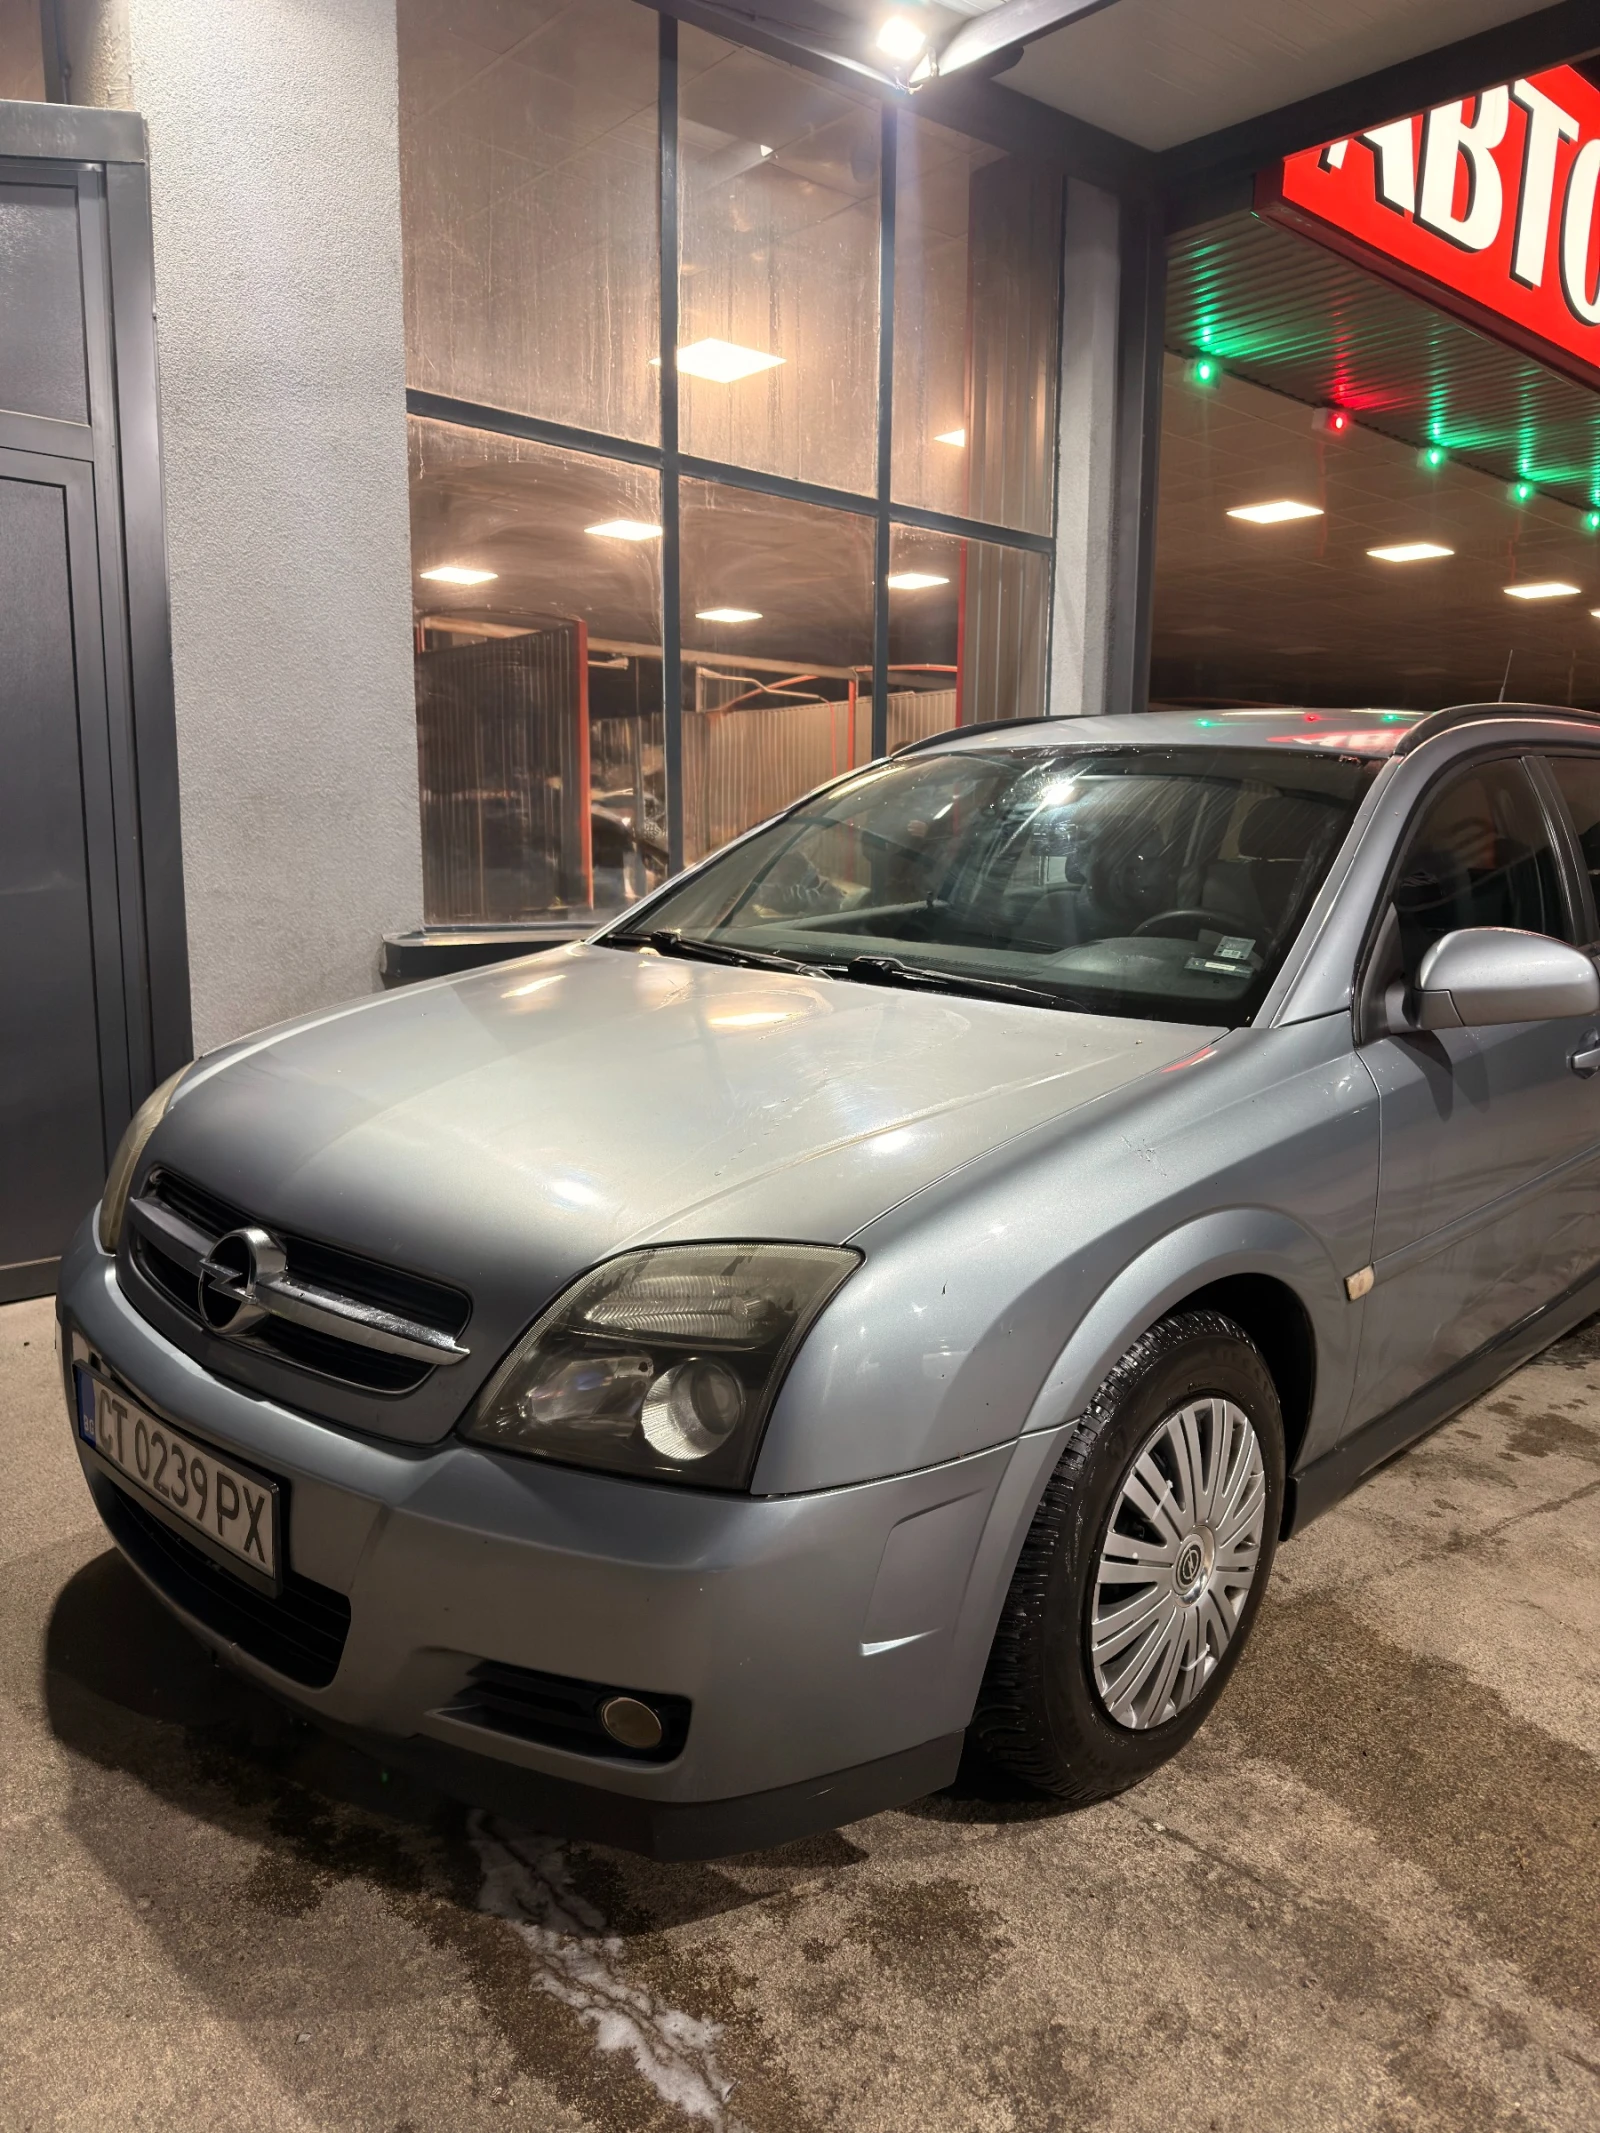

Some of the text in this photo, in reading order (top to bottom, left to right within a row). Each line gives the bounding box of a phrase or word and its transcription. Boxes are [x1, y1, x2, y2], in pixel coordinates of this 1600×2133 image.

[84, 1414, 95, 1435] BG
[134, 1418, 208, 1521] 0239
[216, 1471, 267, 1564] PX
